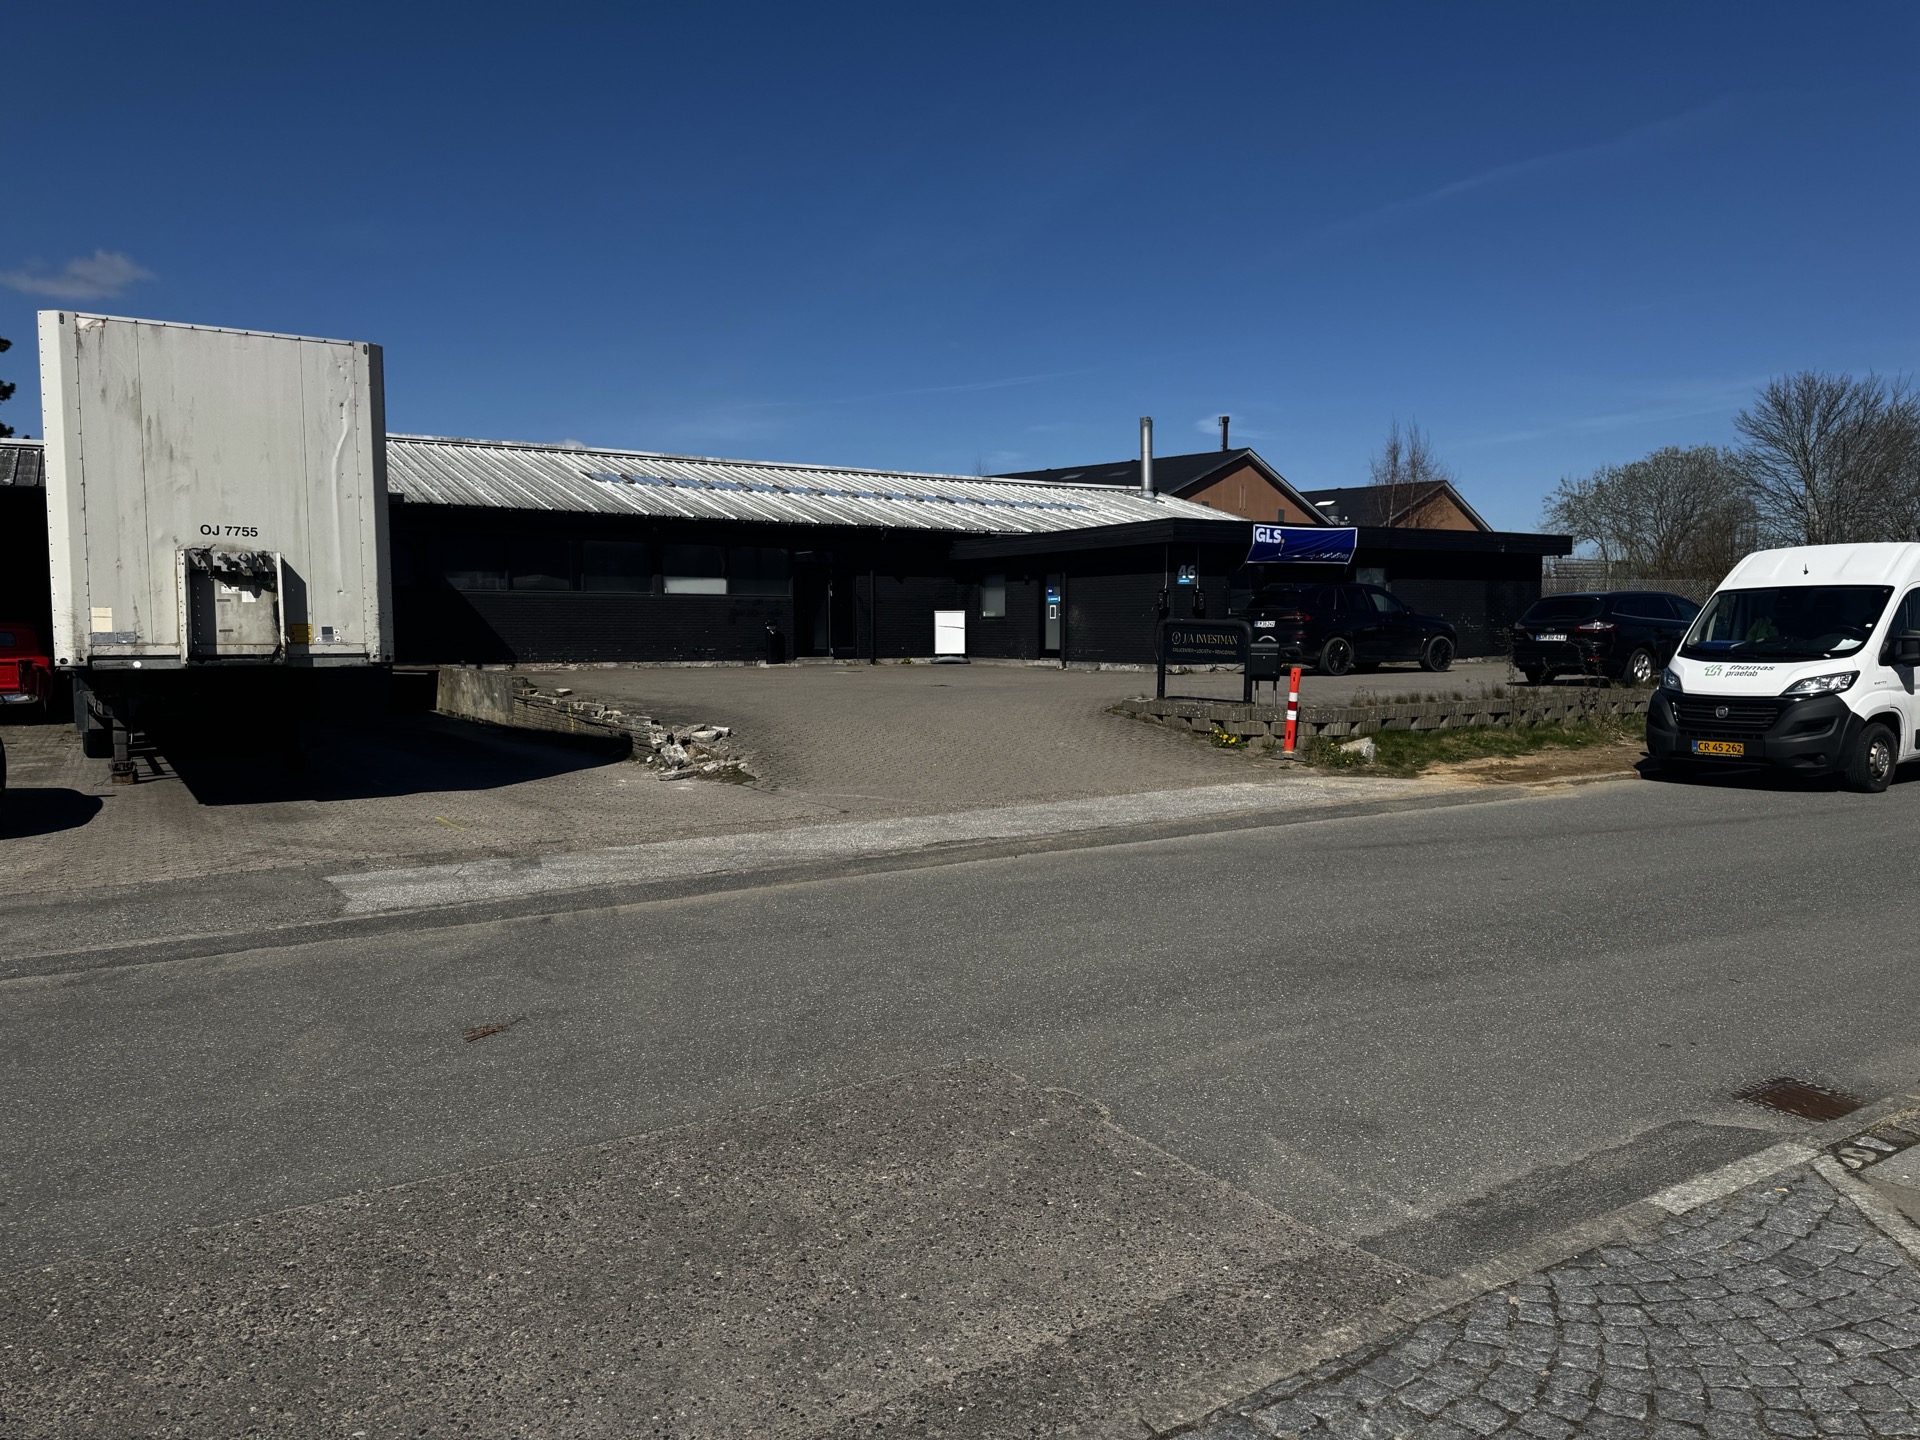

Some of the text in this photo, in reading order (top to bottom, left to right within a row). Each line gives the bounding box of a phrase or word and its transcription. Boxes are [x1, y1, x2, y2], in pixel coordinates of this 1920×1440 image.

[200, 524, 259, 537] OJ 7755
[1177, 564, 1196, 579] 46
[1196, 633, 1238, 645] INVESTMAN
[1698, 742, 1742, 753] CR 45 262
